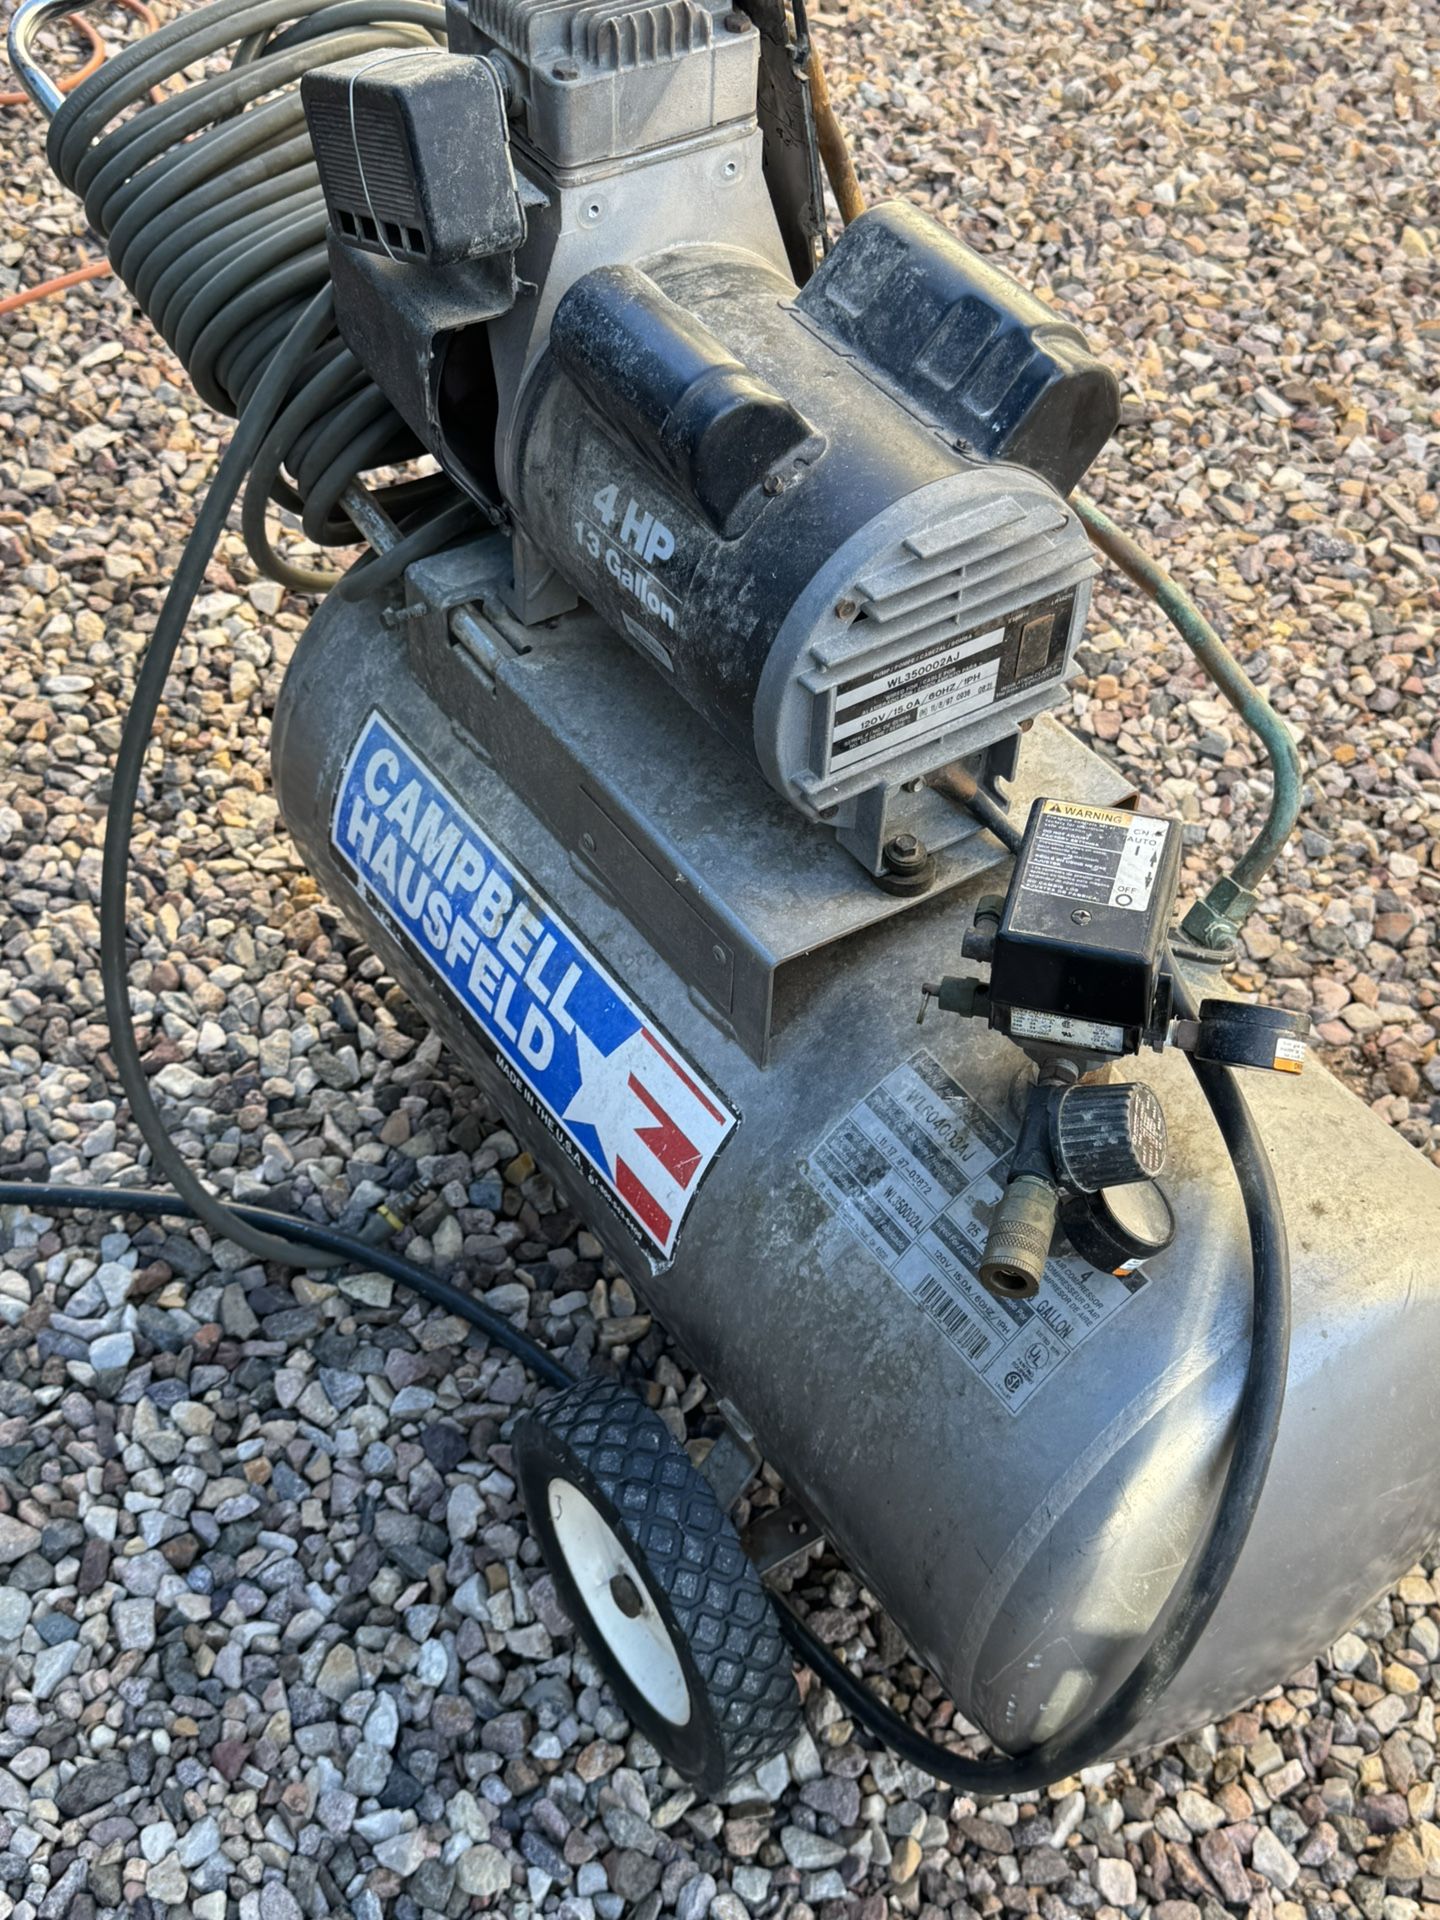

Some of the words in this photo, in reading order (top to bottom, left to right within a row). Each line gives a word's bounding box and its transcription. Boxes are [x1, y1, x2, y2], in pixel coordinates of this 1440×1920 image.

[593, 483, 619, 527] 4
[620, 498, 675, 564] HP
[574, 520, 600, 559] 13
[605, 548, 675, 630] Gallon
[888, 652, 960, 689] WL350002AJ
[1065, 806, 1122, 824] WARNING
[1127, 836, 1157, 847] AUTO
[364, 748, 583, 1035] CAMPBELL
[1117, 886, 1137, 894] OFF
[347, 795, 554, 1072] HAUSFELD
[495, 1054, 523, 1093] MADE
[524, 1090, 534, 1105] IN
[535, 1102, 554, 1132] THE
[963, 1220, 981, 1238] 125
[1039, 1271, 1071, 1305] OMPRESOR
[1068, 1302, 1080, 1313] DE
[1077, 1311, 1093, 1328] AIRE
[1042, 1260, 1085, 1305] COMPRESSEUR
[1082, 1302, 1100, 1321] D'AIR
[1054, 1257, 1067, 1271] AIR
[1064, 1268, 1104, 1310] COMPRESSOR
[1080, 1270, 1094, 1284] 4
[1034, 1298, 1074, 1340] GALLON
